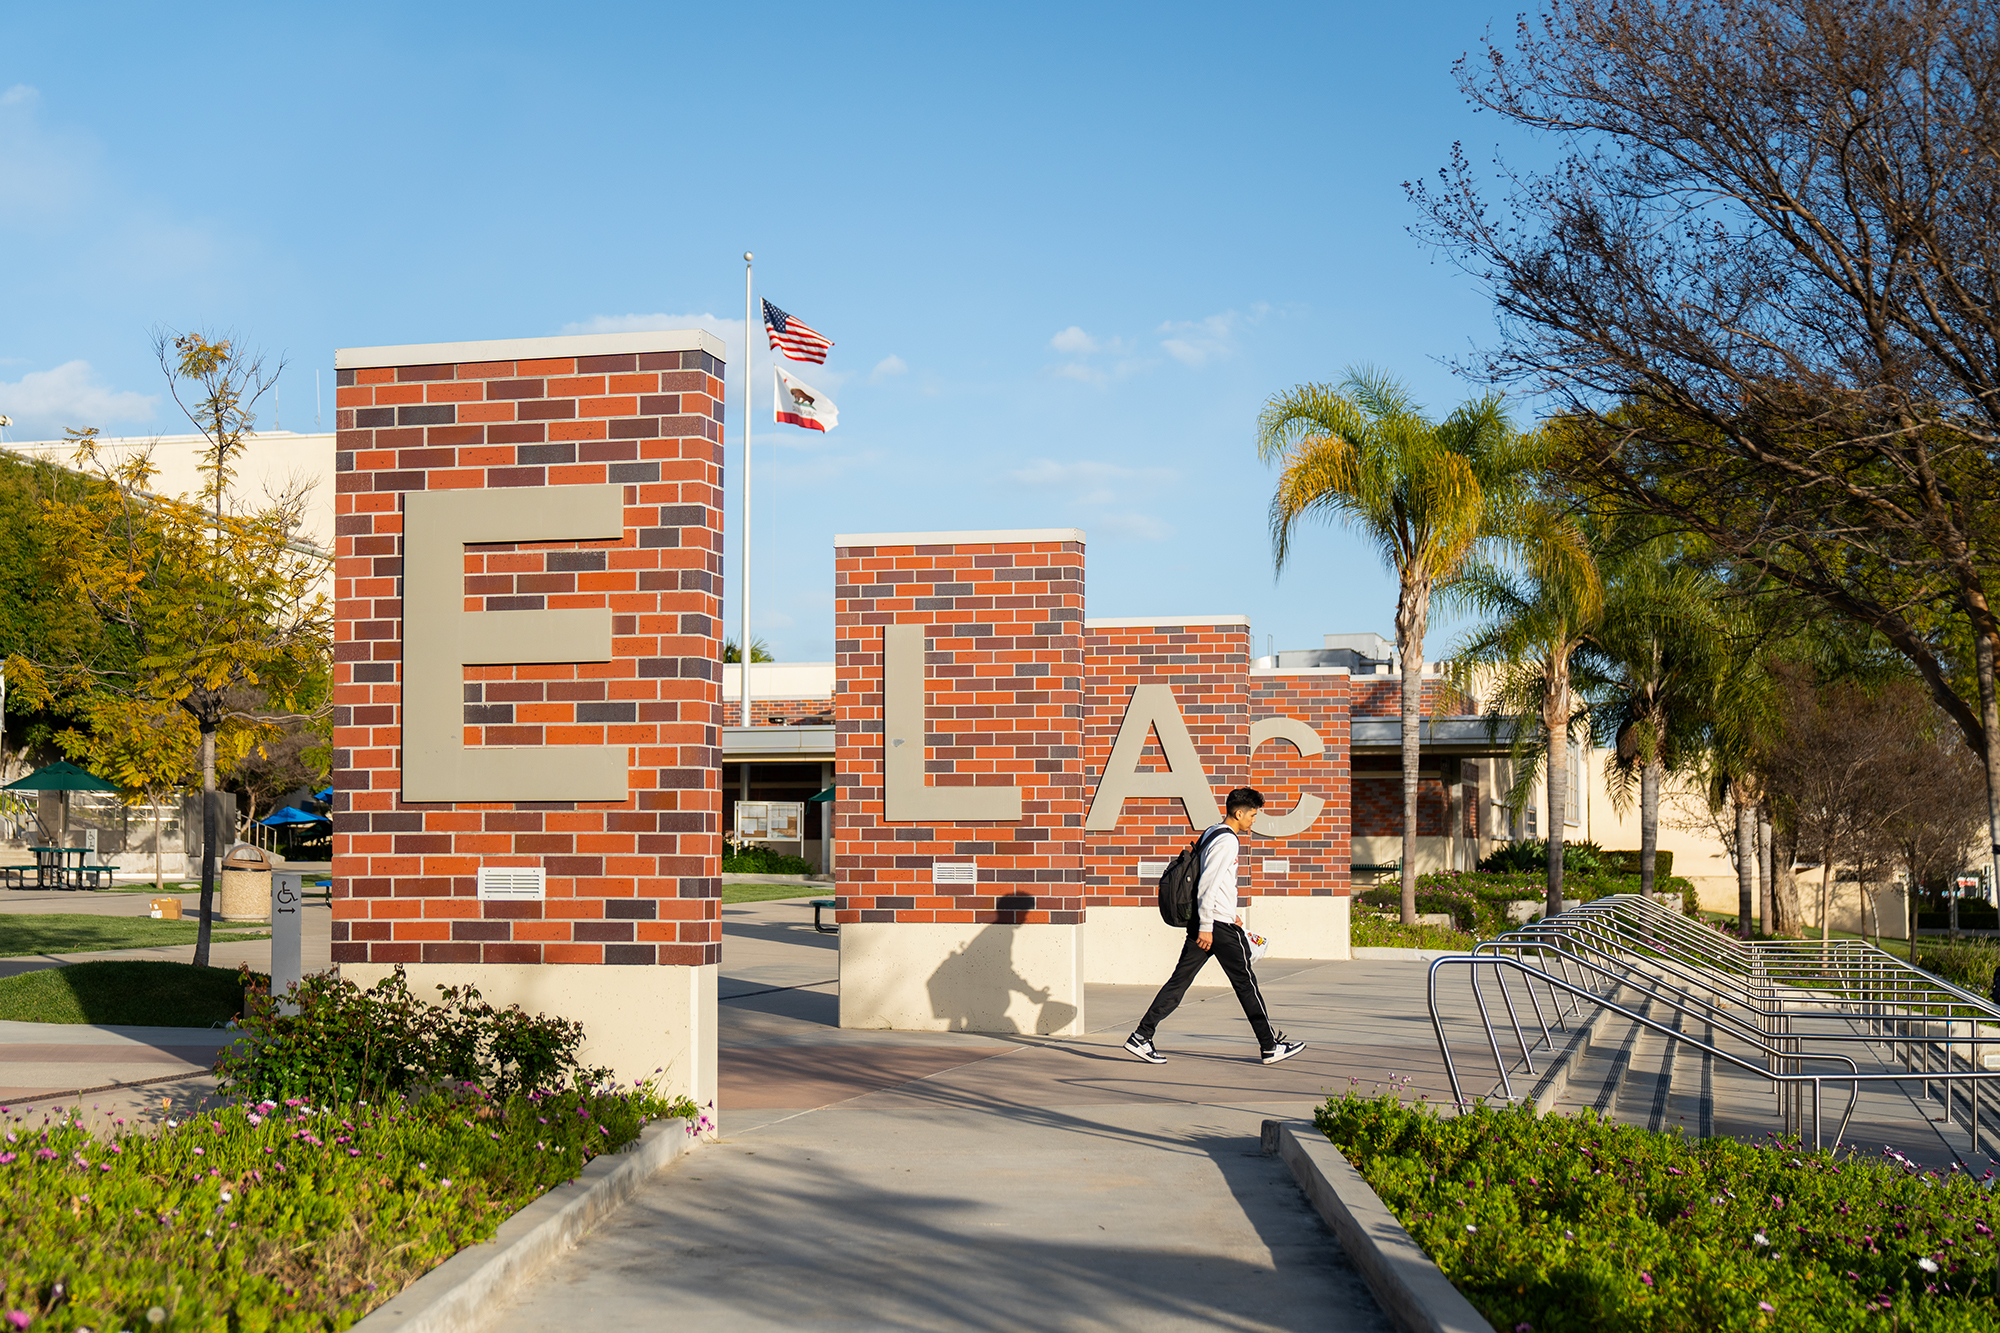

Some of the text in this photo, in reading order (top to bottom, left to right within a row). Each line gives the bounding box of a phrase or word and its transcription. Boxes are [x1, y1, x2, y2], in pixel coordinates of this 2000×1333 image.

[403, 484, 628, 802] E
[885, 624, 1022, 821] L
[1085, 684, 1224, 831] A
[1250, 717, 1326, 837] C
